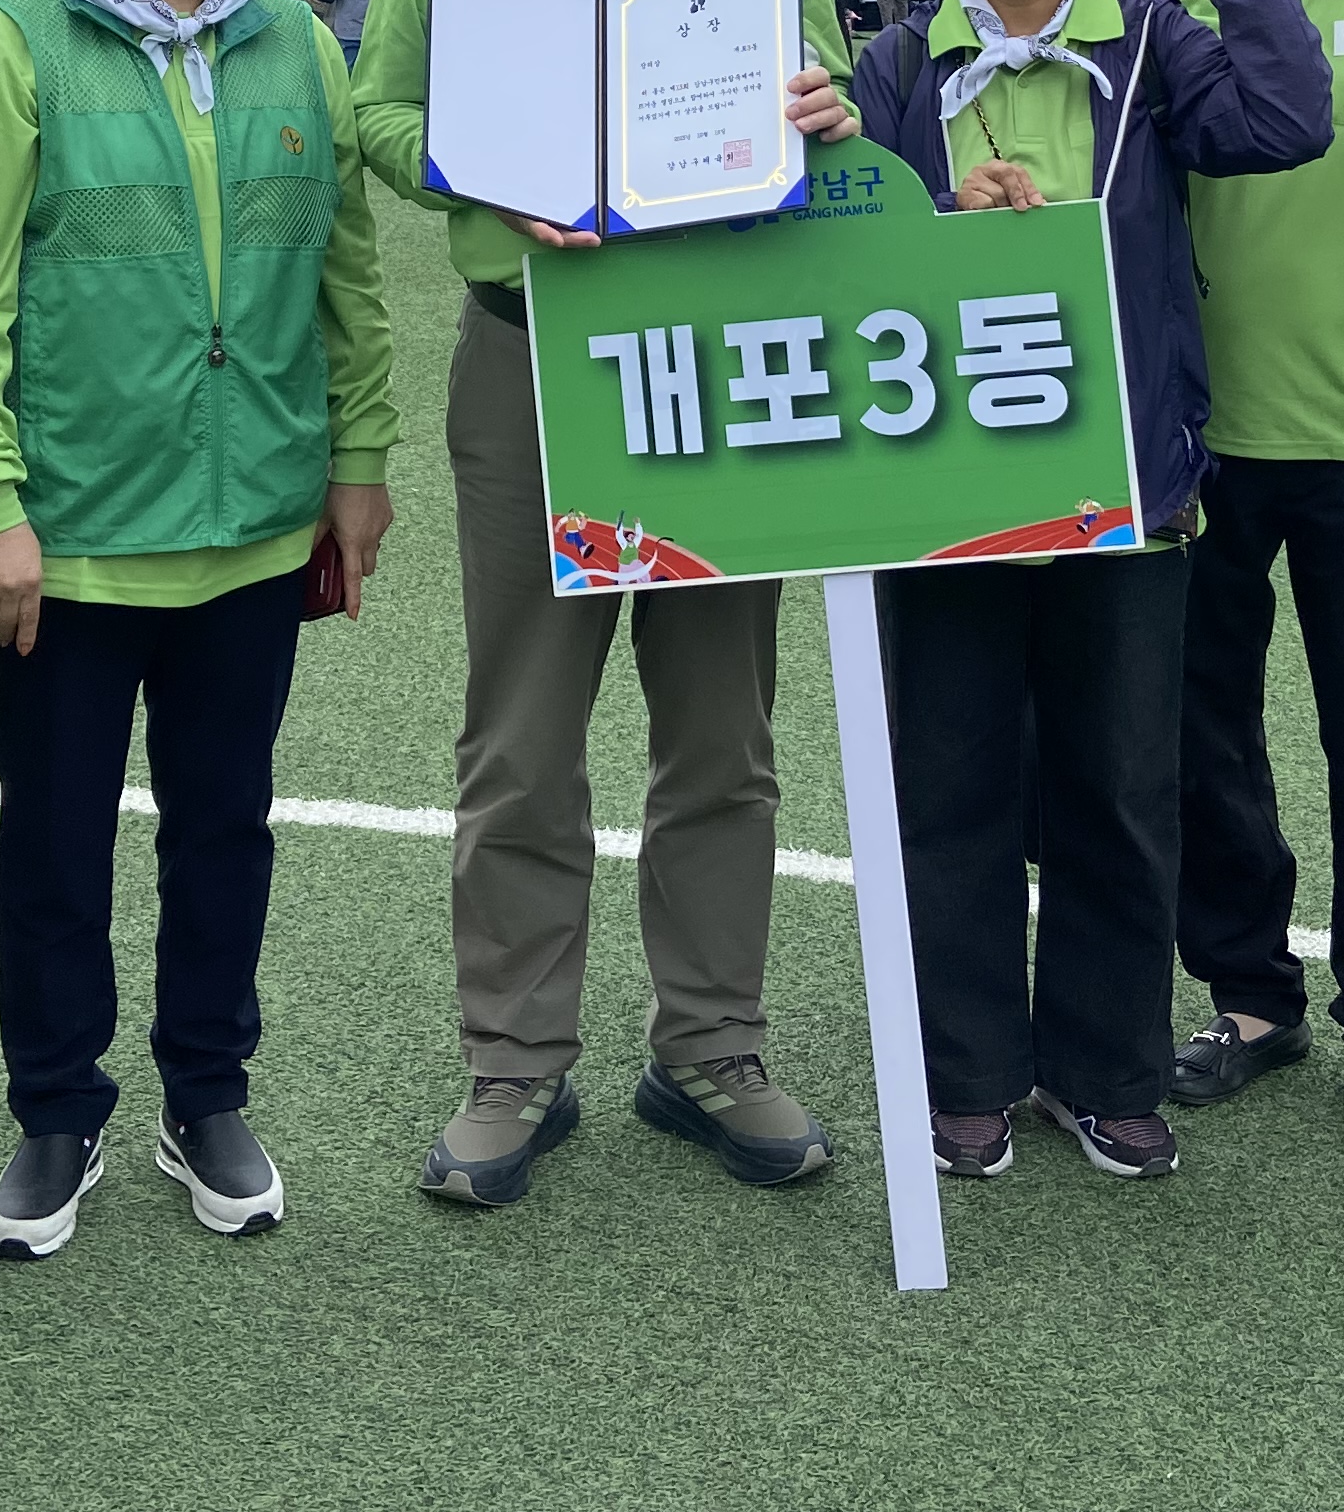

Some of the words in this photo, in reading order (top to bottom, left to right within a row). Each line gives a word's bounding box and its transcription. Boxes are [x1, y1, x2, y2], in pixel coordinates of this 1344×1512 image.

[793, 206, 832, 220] GANG
[833, 204, 863, 217] NAM
[864, 202, 884, 214] GU
[587, 291, 1074, 455] 개포3동
